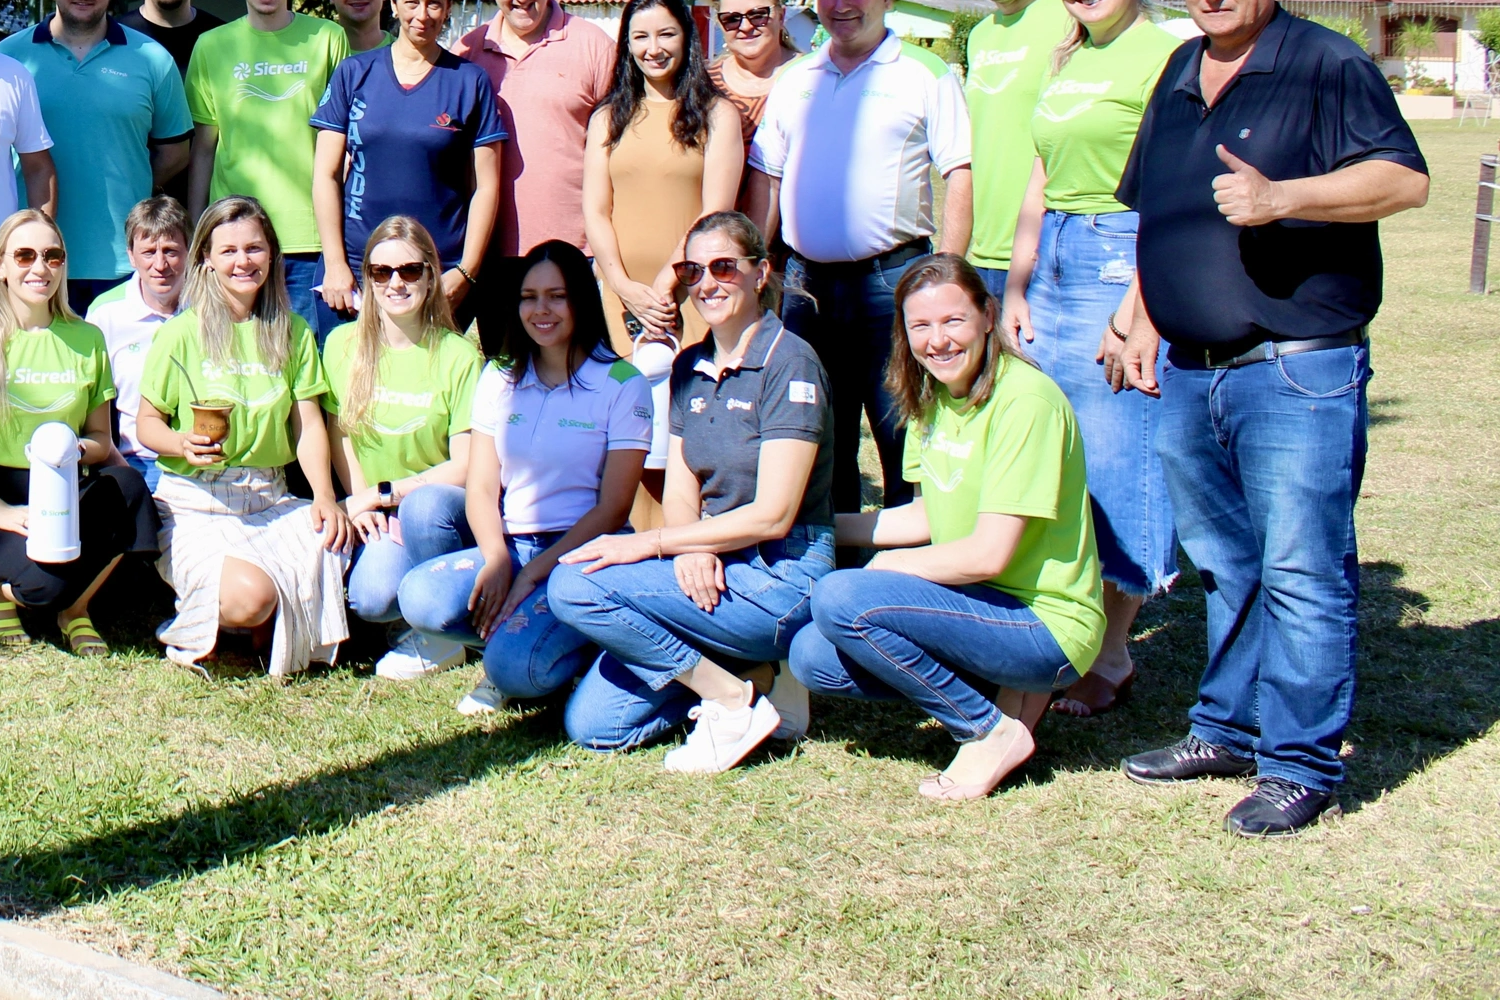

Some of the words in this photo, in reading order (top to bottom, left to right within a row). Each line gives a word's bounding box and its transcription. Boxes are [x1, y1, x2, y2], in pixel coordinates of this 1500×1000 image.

[254, 61, 308, 76] Sicredi
[14, 368, 76, 384] Sicredi
[567, 420, 596, 430] Sicredi
